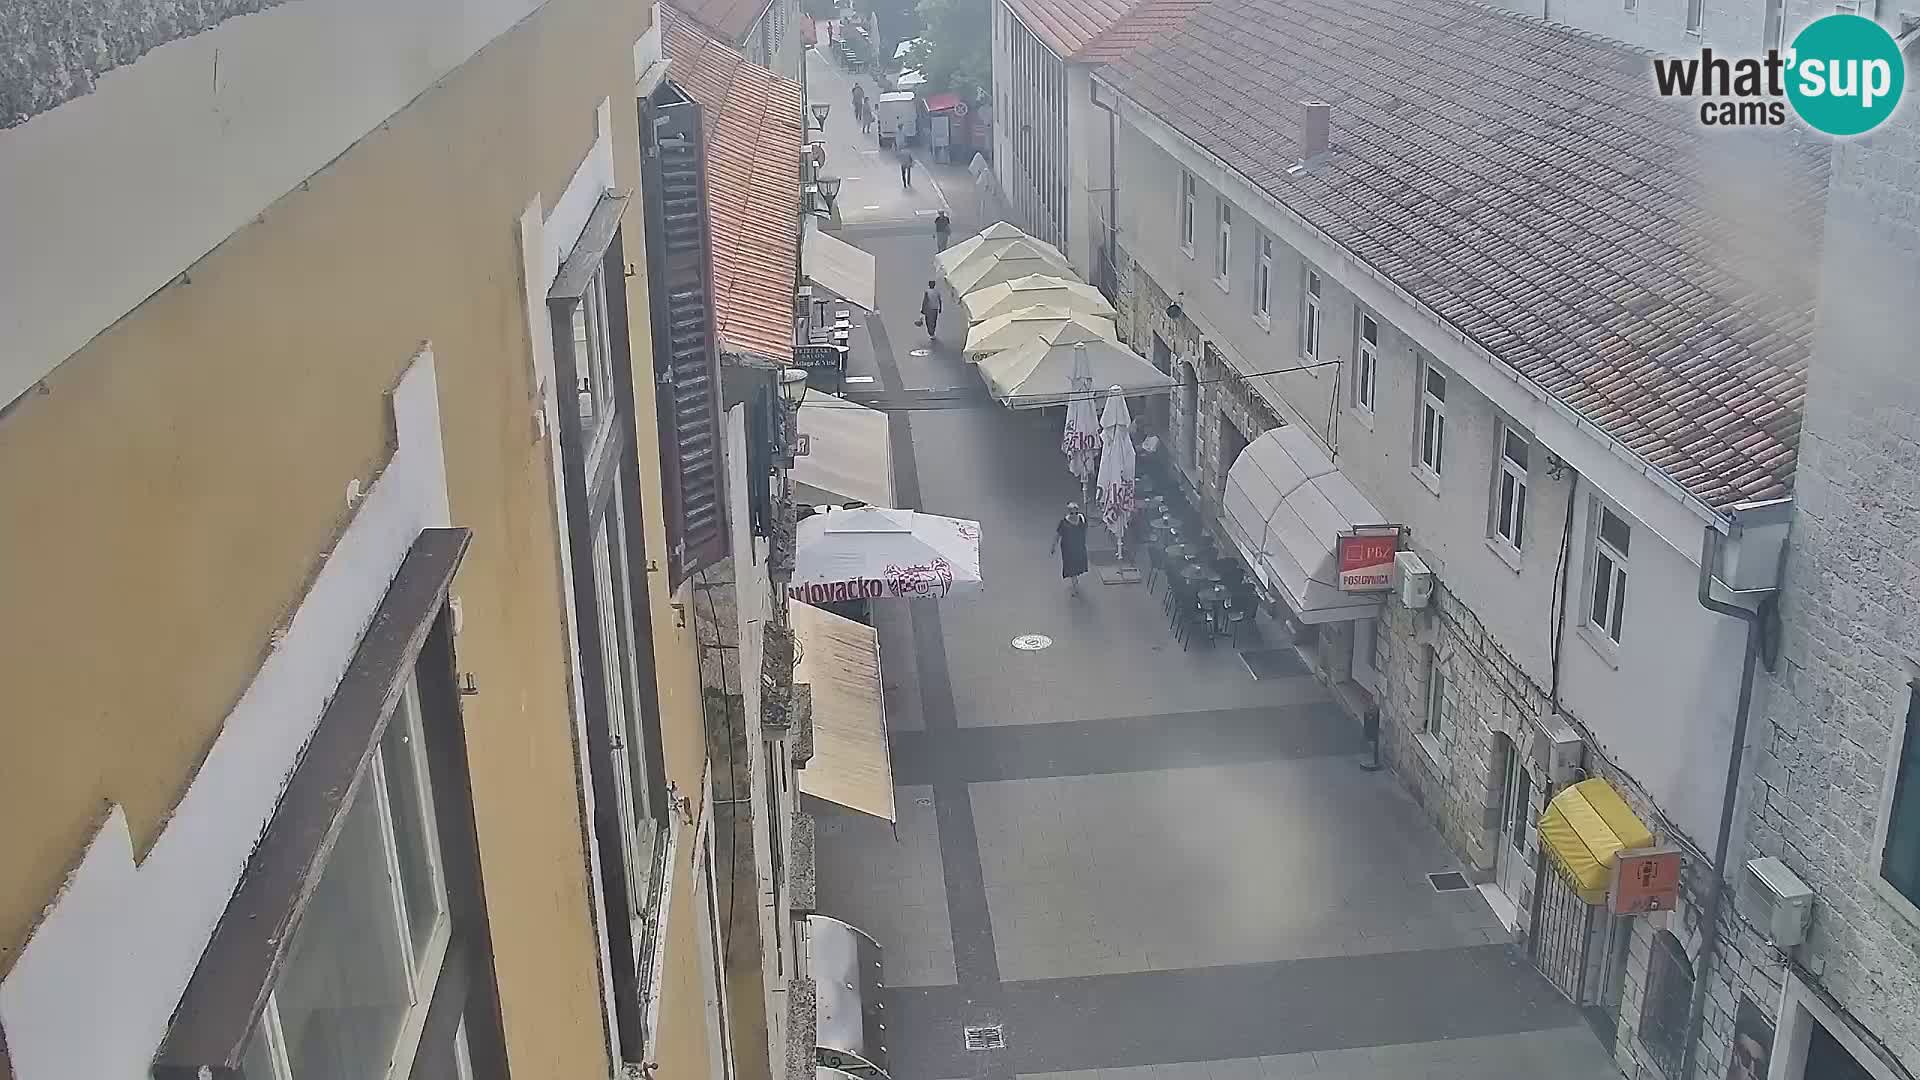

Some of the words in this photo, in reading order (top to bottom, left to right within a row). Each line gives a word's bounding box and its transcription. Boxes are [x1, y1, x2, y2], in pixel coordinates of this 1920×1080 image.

[1366, 545, 1392, 558] PBZ
[1343, 575, 1389, 586] POSLOVNICA
[788, 576, 883, 604] arlovačko
